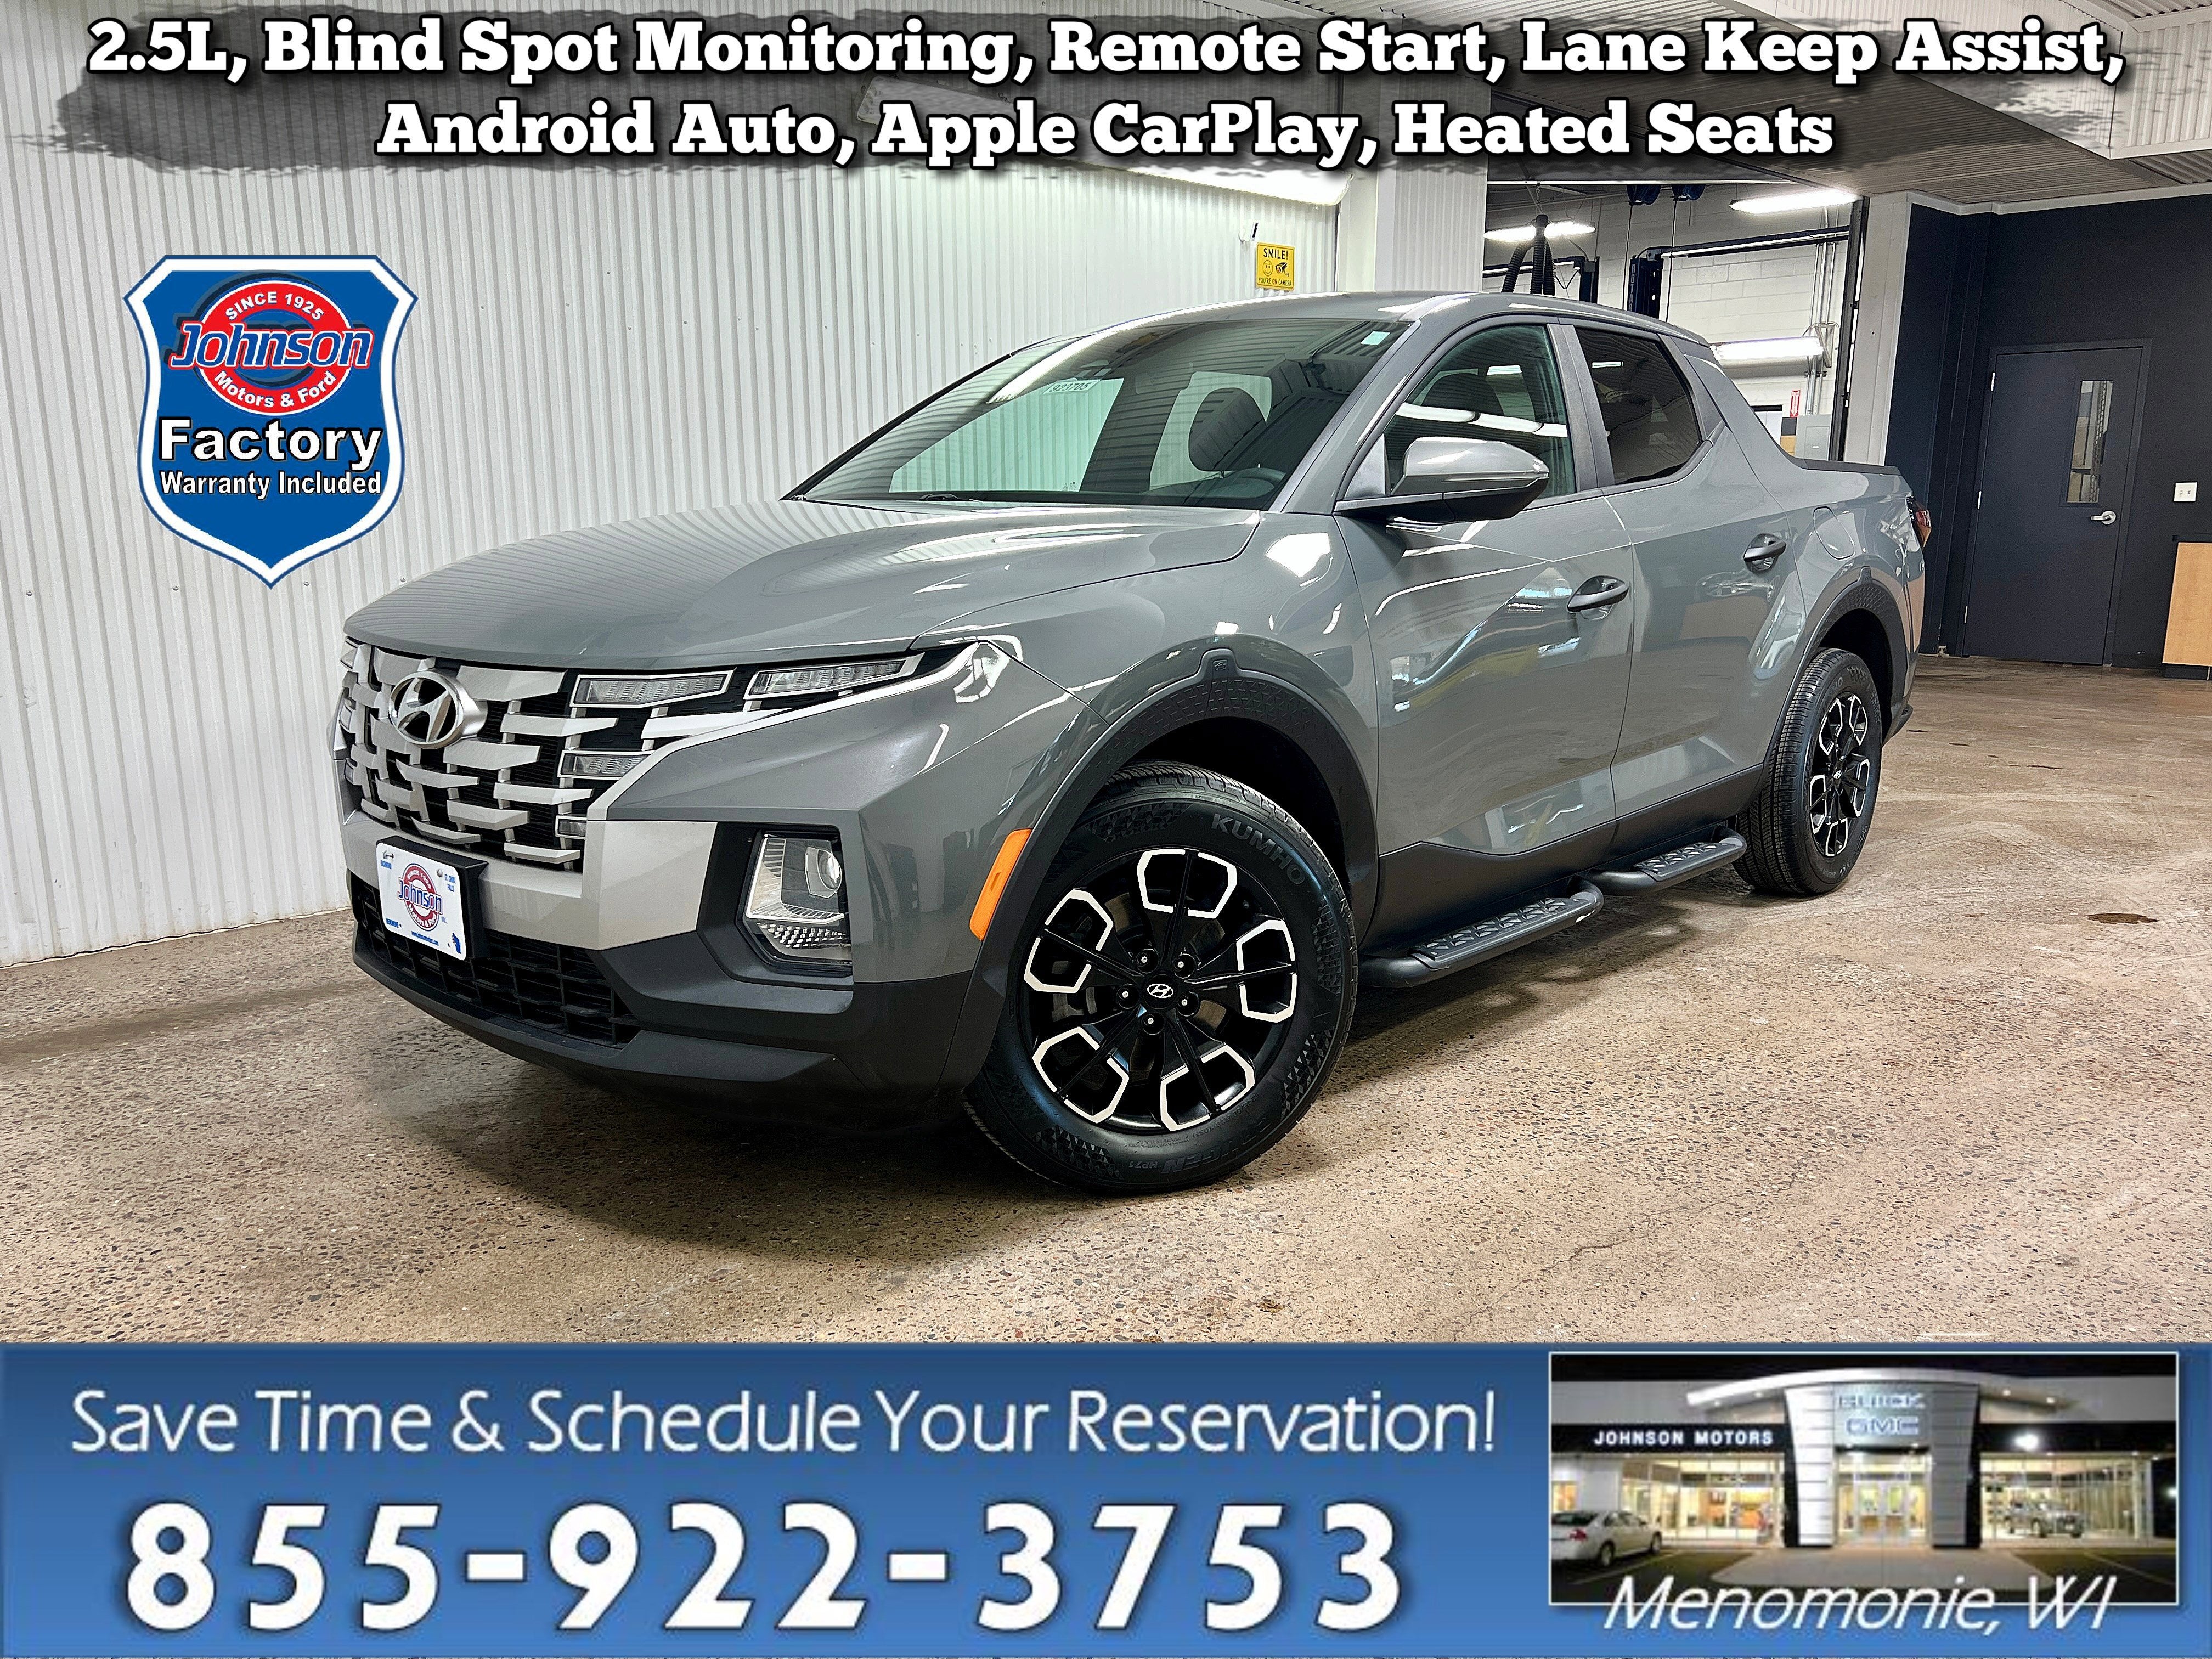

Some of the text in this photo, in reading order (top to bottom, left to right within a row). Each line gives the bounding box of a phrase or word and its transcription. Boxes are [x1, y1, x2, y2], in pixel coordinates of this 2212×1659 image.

[1263, 247, 1288, 261] SMILE!
[1210, 813, 1306, 885] KUMHO
[397, 879, 443, 914] Johnson
[1128, 1160, 1158, 1169] HP71
[1839, 1393, 1926, 1409] BUICK
[1844, 1417, 1919, 1435] GMC
[1594, 1430, 1774, 1446] JOHNSON MOTORS
